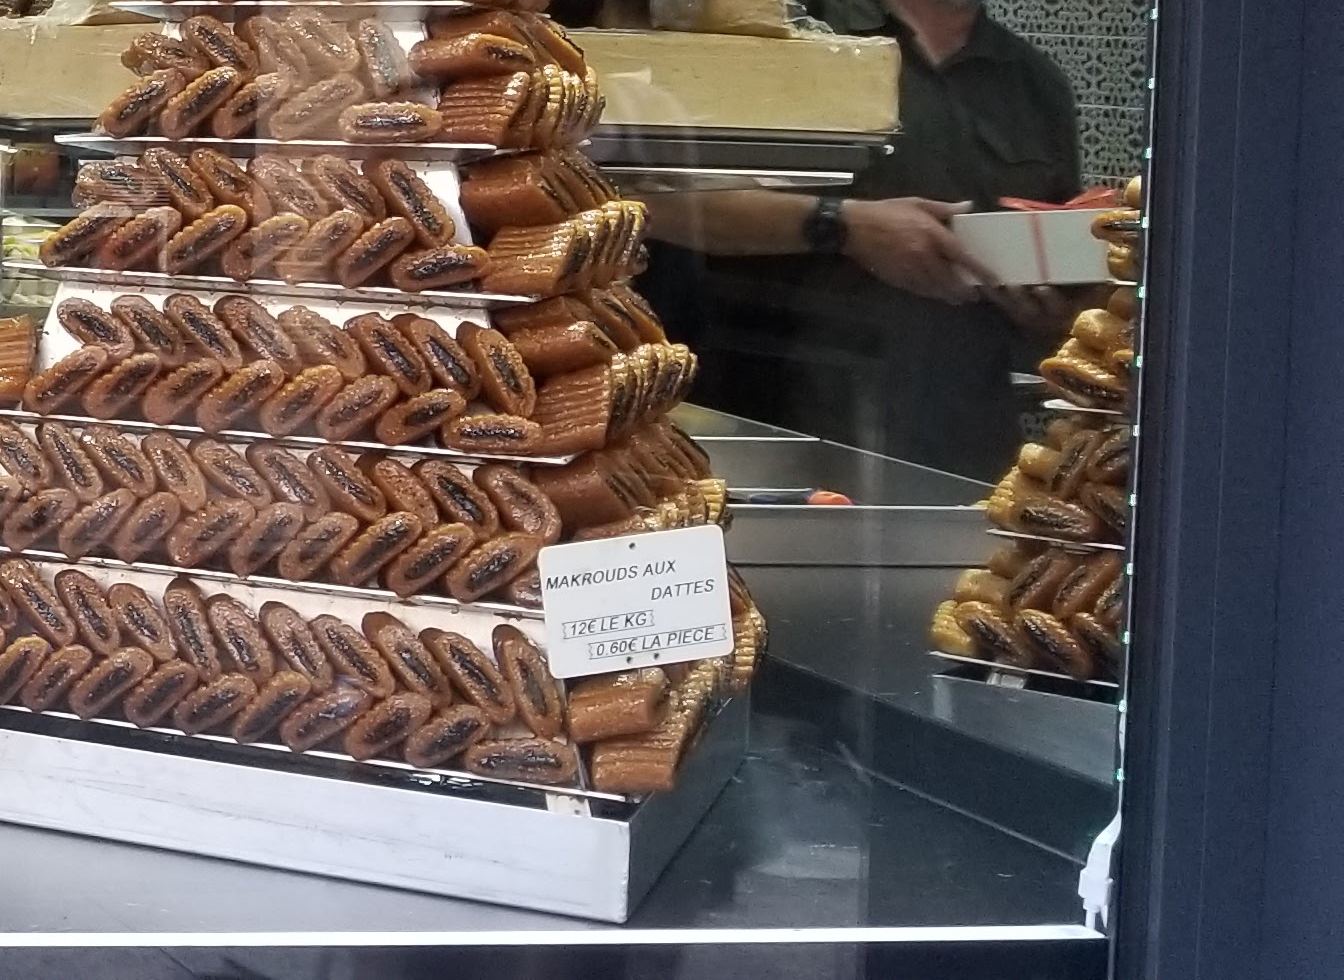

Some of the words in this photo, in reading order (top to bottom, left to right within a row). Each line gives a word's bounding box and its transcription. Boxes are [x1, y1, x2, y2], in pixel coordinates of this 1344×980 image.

[545, 565, 638, 591] MAKROUDS
[642, 560, 677, 578] AUX
[650, 579, 715, 601] DATTES
[570, 620, 597, 636] 12€
[600, 617, 619, 632] LE
[624, 613, 647, 628] KG
[596, 638, 638, 657] 0.60€
[641, 635, 662, 651] LA
[666, 627, 715, 647] PIECE
